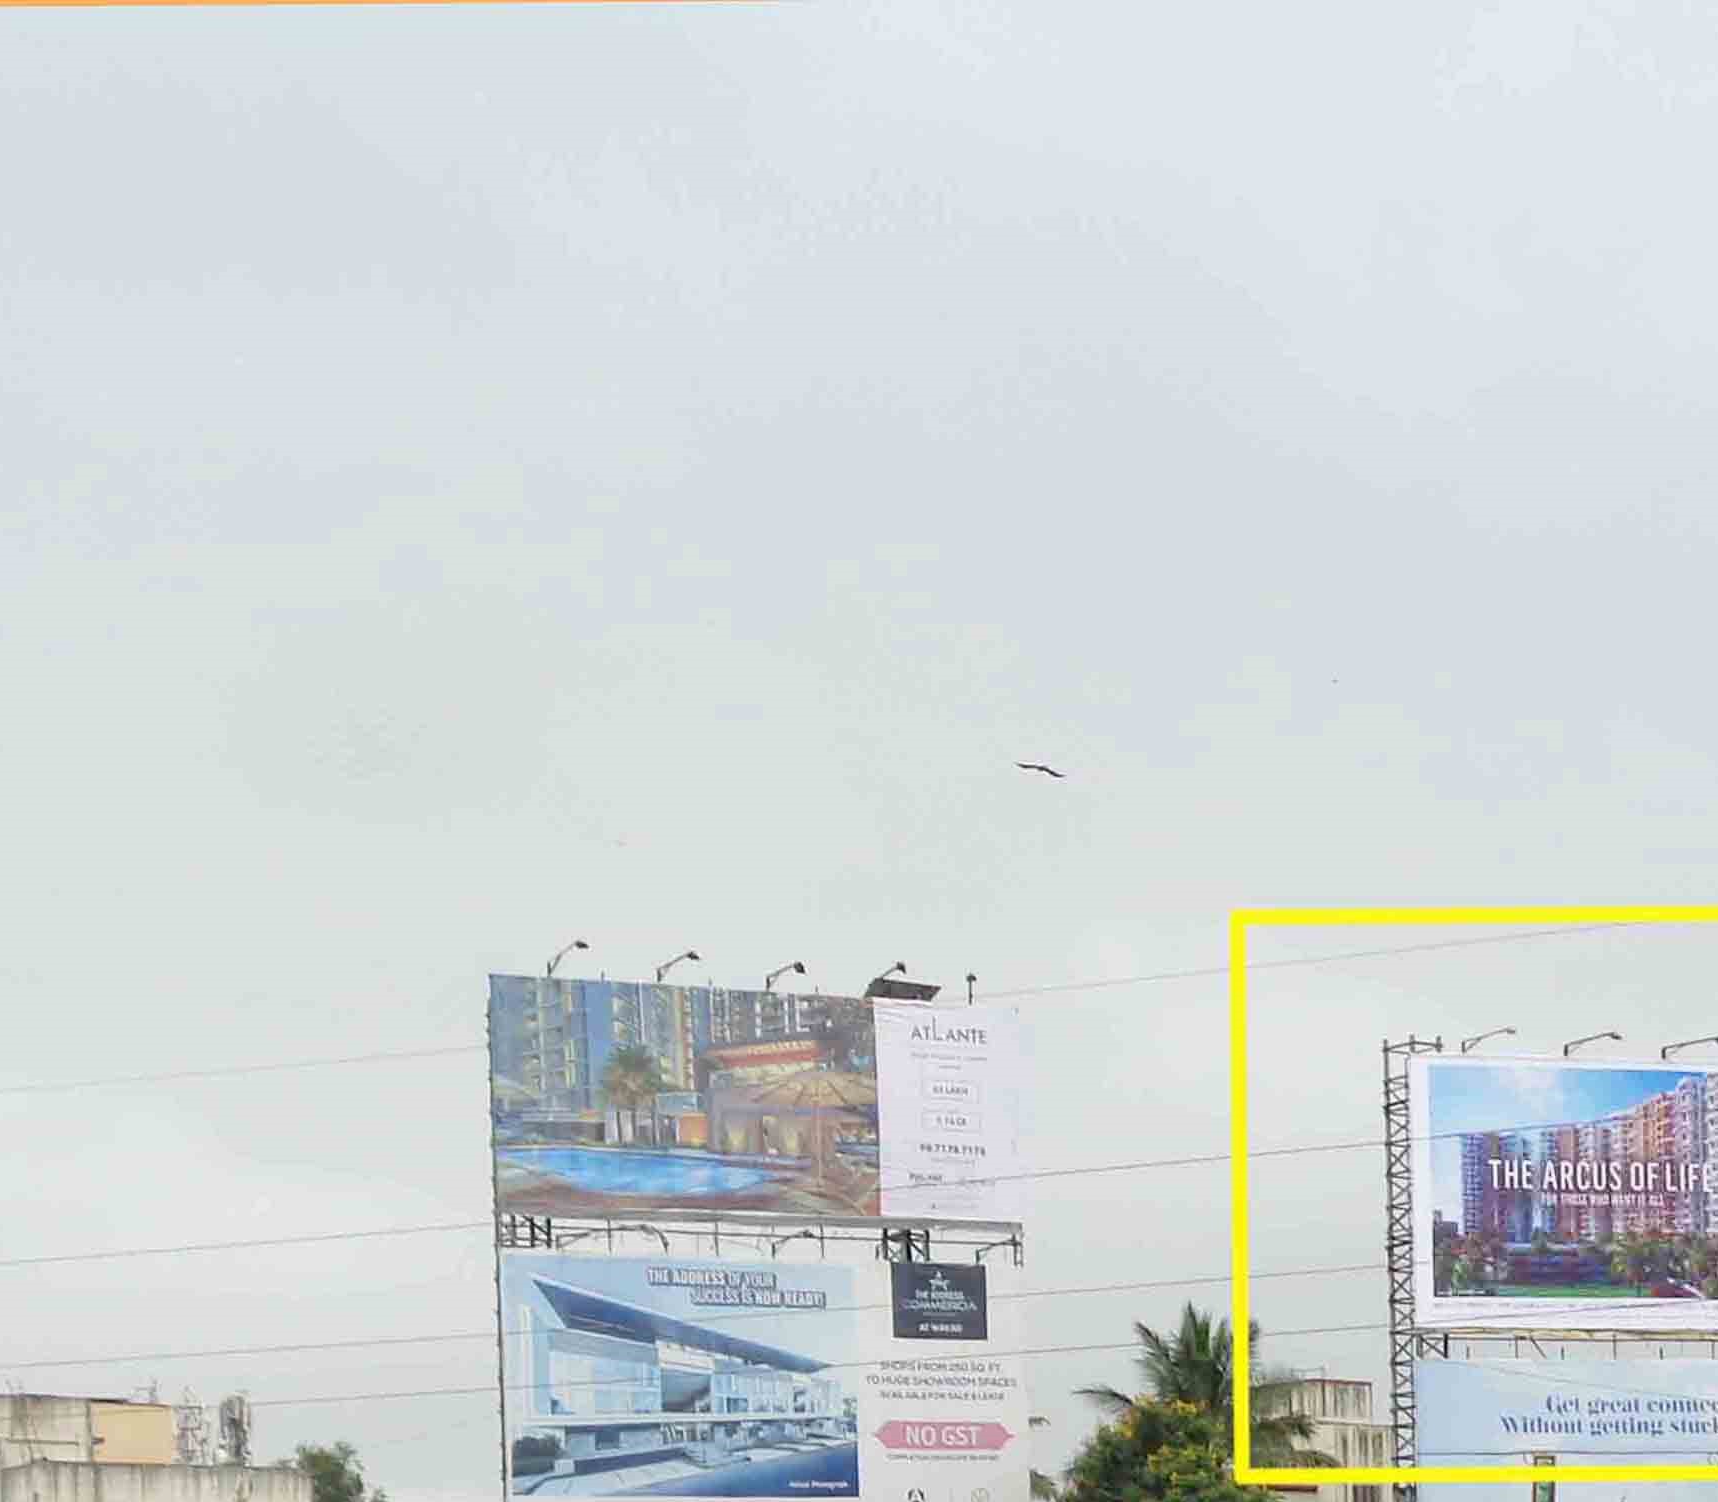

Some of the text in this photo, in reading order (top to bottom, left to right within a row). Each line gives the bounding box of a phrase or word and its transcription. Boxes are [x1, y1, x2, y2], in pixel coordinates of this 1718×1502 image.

[910, 1016, 988, 1046] ATLANTE
[1488, 1158, 1717, 1193] THE ARCUS OF LIFE
[1545, 1394, 1580, 1414] Get
[1586, 1396, 1641, 1416] great
[905, 1424, 982, 1447] NO GST
[1499, 1415, 1583, 1435] Without
[1589, 1417, 1666, 1437] getting
